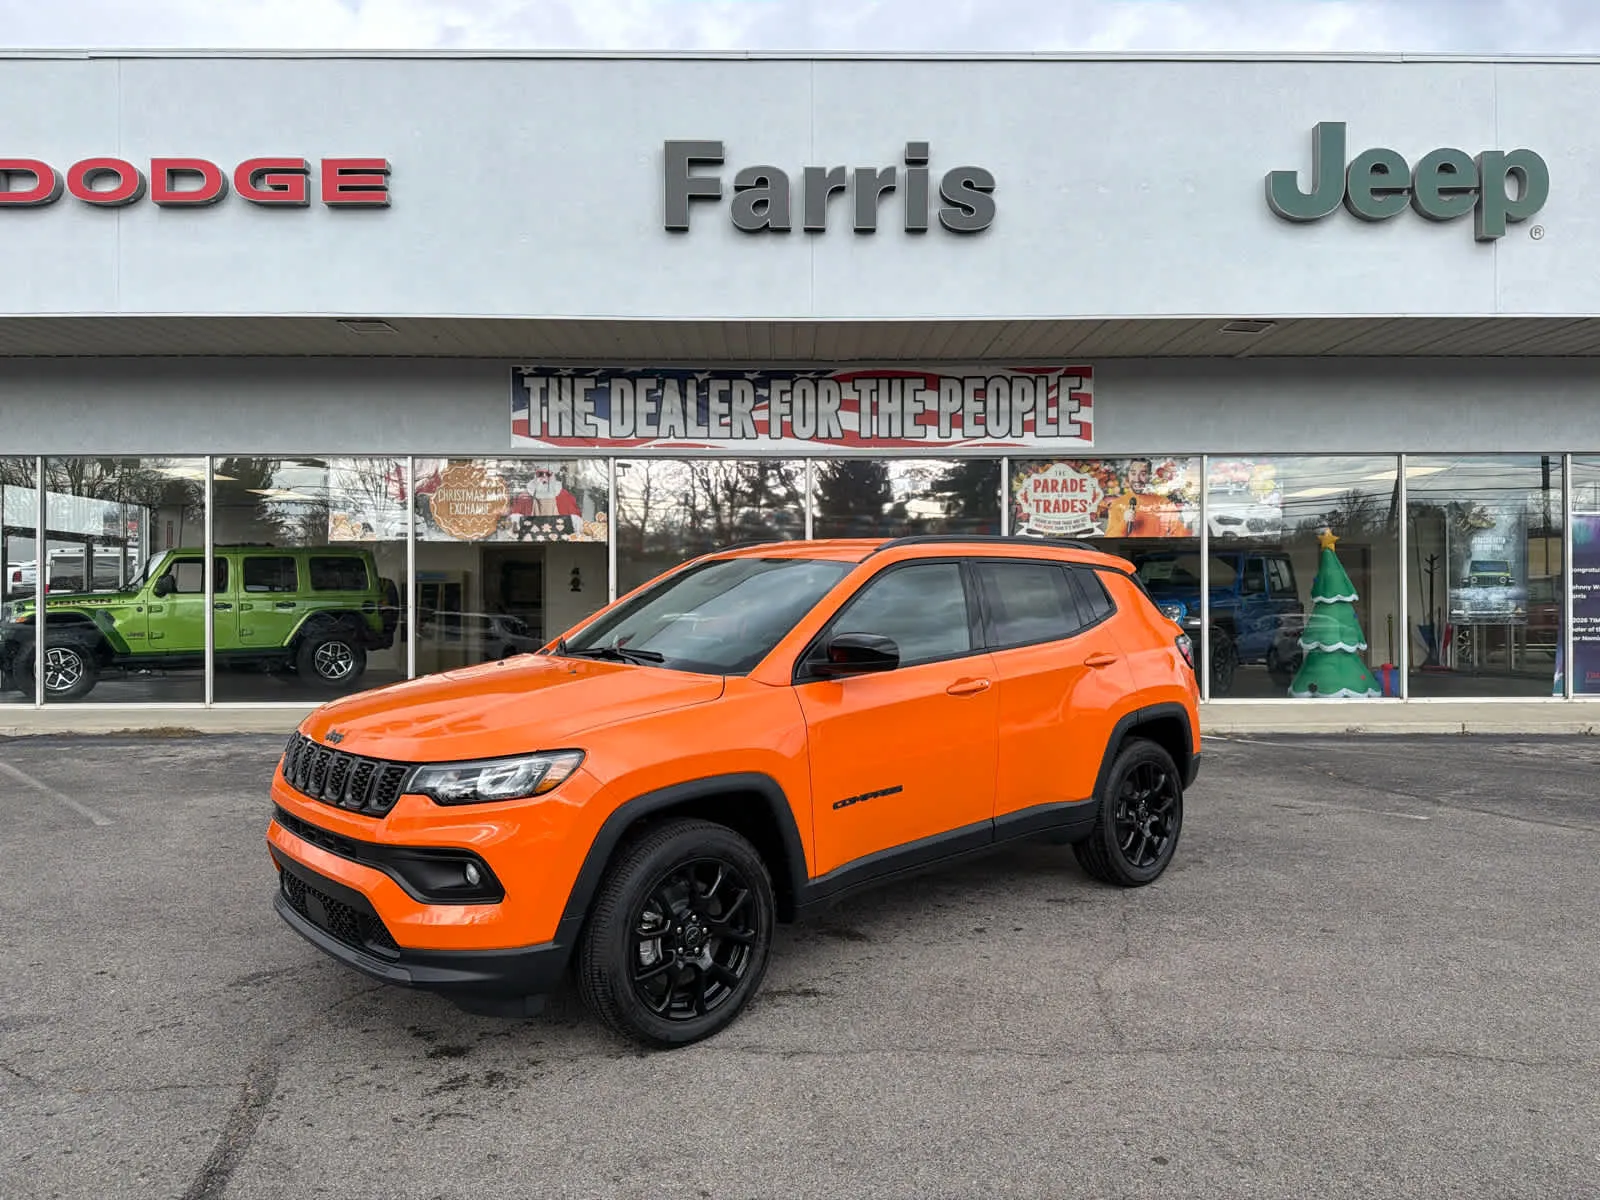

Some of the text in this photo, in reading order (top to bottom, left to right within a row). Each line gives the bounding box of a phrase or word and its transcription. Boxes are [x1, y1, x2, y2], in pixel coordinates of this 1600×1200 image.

[0, 157, 391, 208] DODGE
[663, 139, 997, 234] Farris
[1265, 121, 1550, 242] Jeep
[522, 375, 1083, 440] THE DEALER FOR THE PEOPLE
[438, 486, 485, 503] CHRISTMAS
[1033, 478, 1088, 493] PARADE
[1033, 498, 1088, 513] TRADES
[44, 598, 112, 607] UBICON
